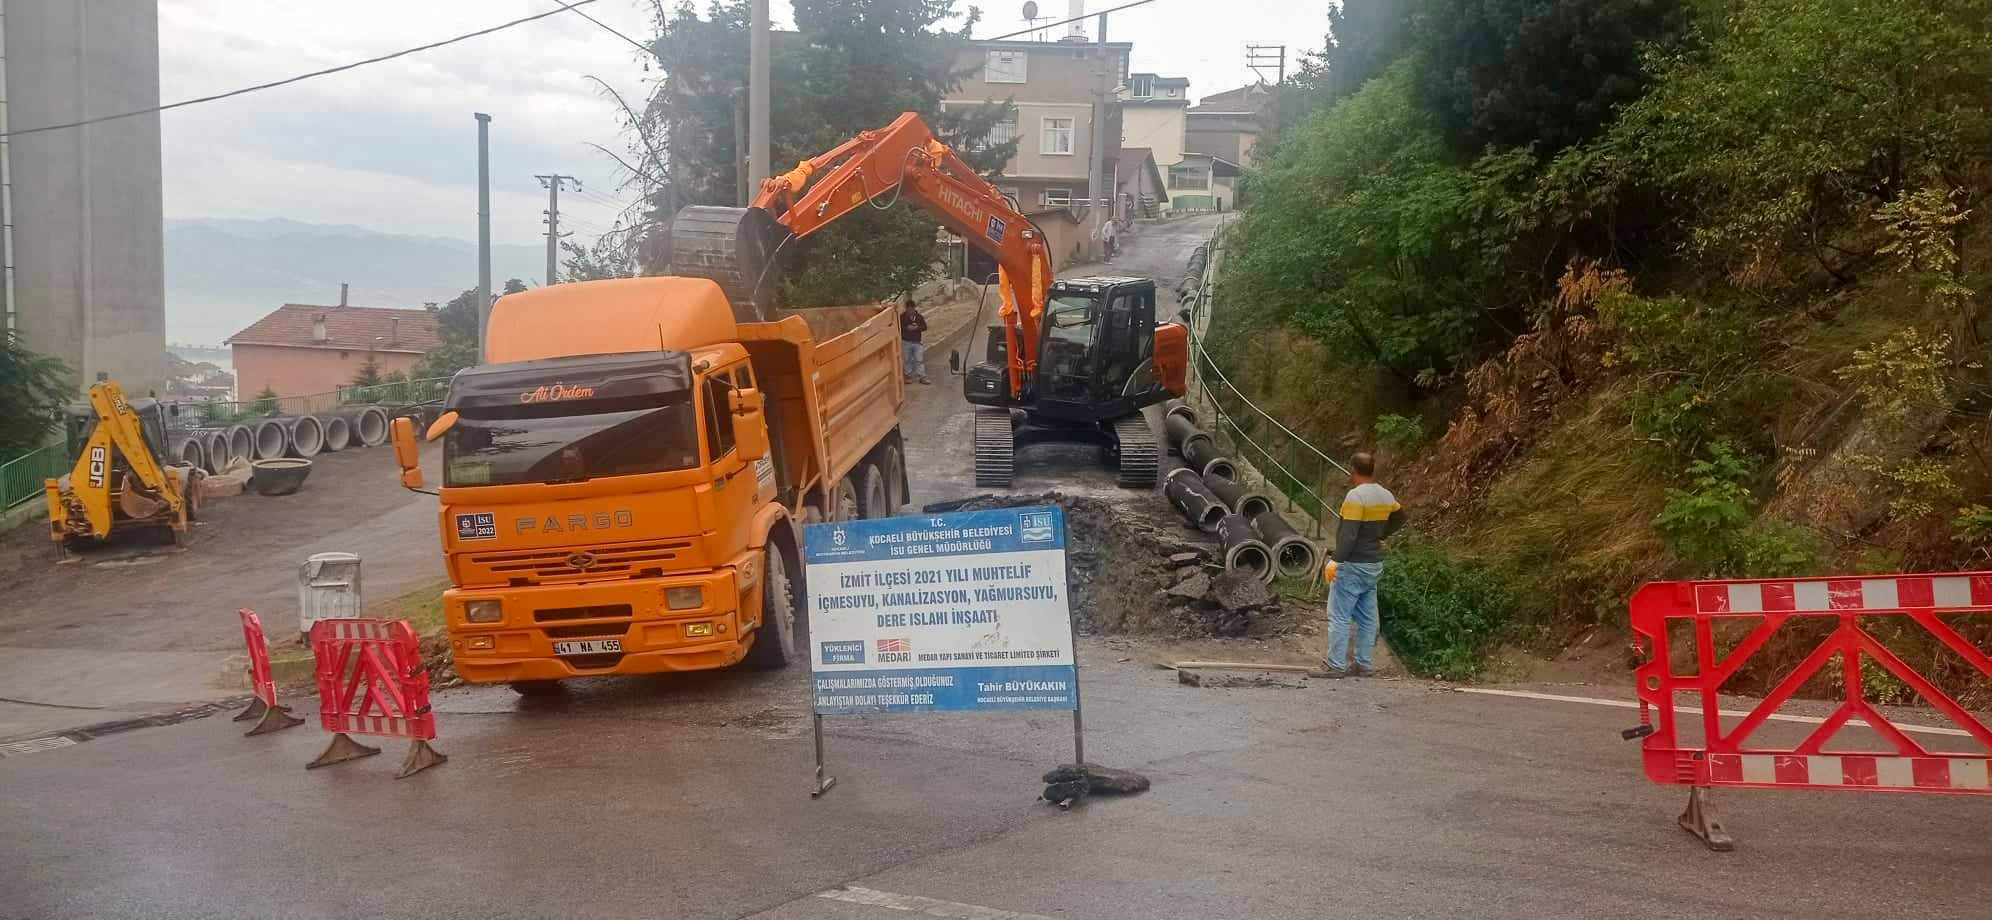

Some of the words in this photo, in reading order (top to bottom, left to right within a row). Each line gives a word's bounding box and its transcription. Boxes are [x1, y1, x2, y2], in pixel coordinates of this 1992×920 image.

[939, 184, 983, 223] HITACHI
[90, 448, 105, 488] JCB
[478, 527, 494, 536] 2022
[515, 510, 633, 536] FARGO
[931, 518, 947, 528] T.C.
[869, 531, 904, 545] KOCAELİ
[906, 528, 960, 543] BÜYÜKŞEHİR
[962, 524, 1013, 538] BELEDİYESİ
[890, 544, 905, 556] İSU
[906, 543, 934, 555] GENEL
[936, 540, 992, 553] MÜDÜRLÜĞÜ
[840, 572, 872, 588] İZMİT
[874, 568, 911, 589] İLÇESİ
[914, 570, 942, 584] 2021
[946, 568, 969, 582] YILI
[972, 562, 1031, 581] MUHTELİF
[818, 594, 879, 613] İÇMESUYU,
[882, 589, 971, 607] KANALİZASYON,
[974, 584, 1057, 602] YAĞMURSUYU,
[877, 613, 907, 628] DERE
[910, 611, 948, 626] ISLAHI
[951, 608, 998, 628] İNŞAATI
[560, 643, 571, 653] 41
[601, 640, 619, 651] 455
[975, 651, 983, 660] VE
[977, 682, 1003, 692] Tahir
[1005, 679, 1066, 691] BÜYÜKAKIN
